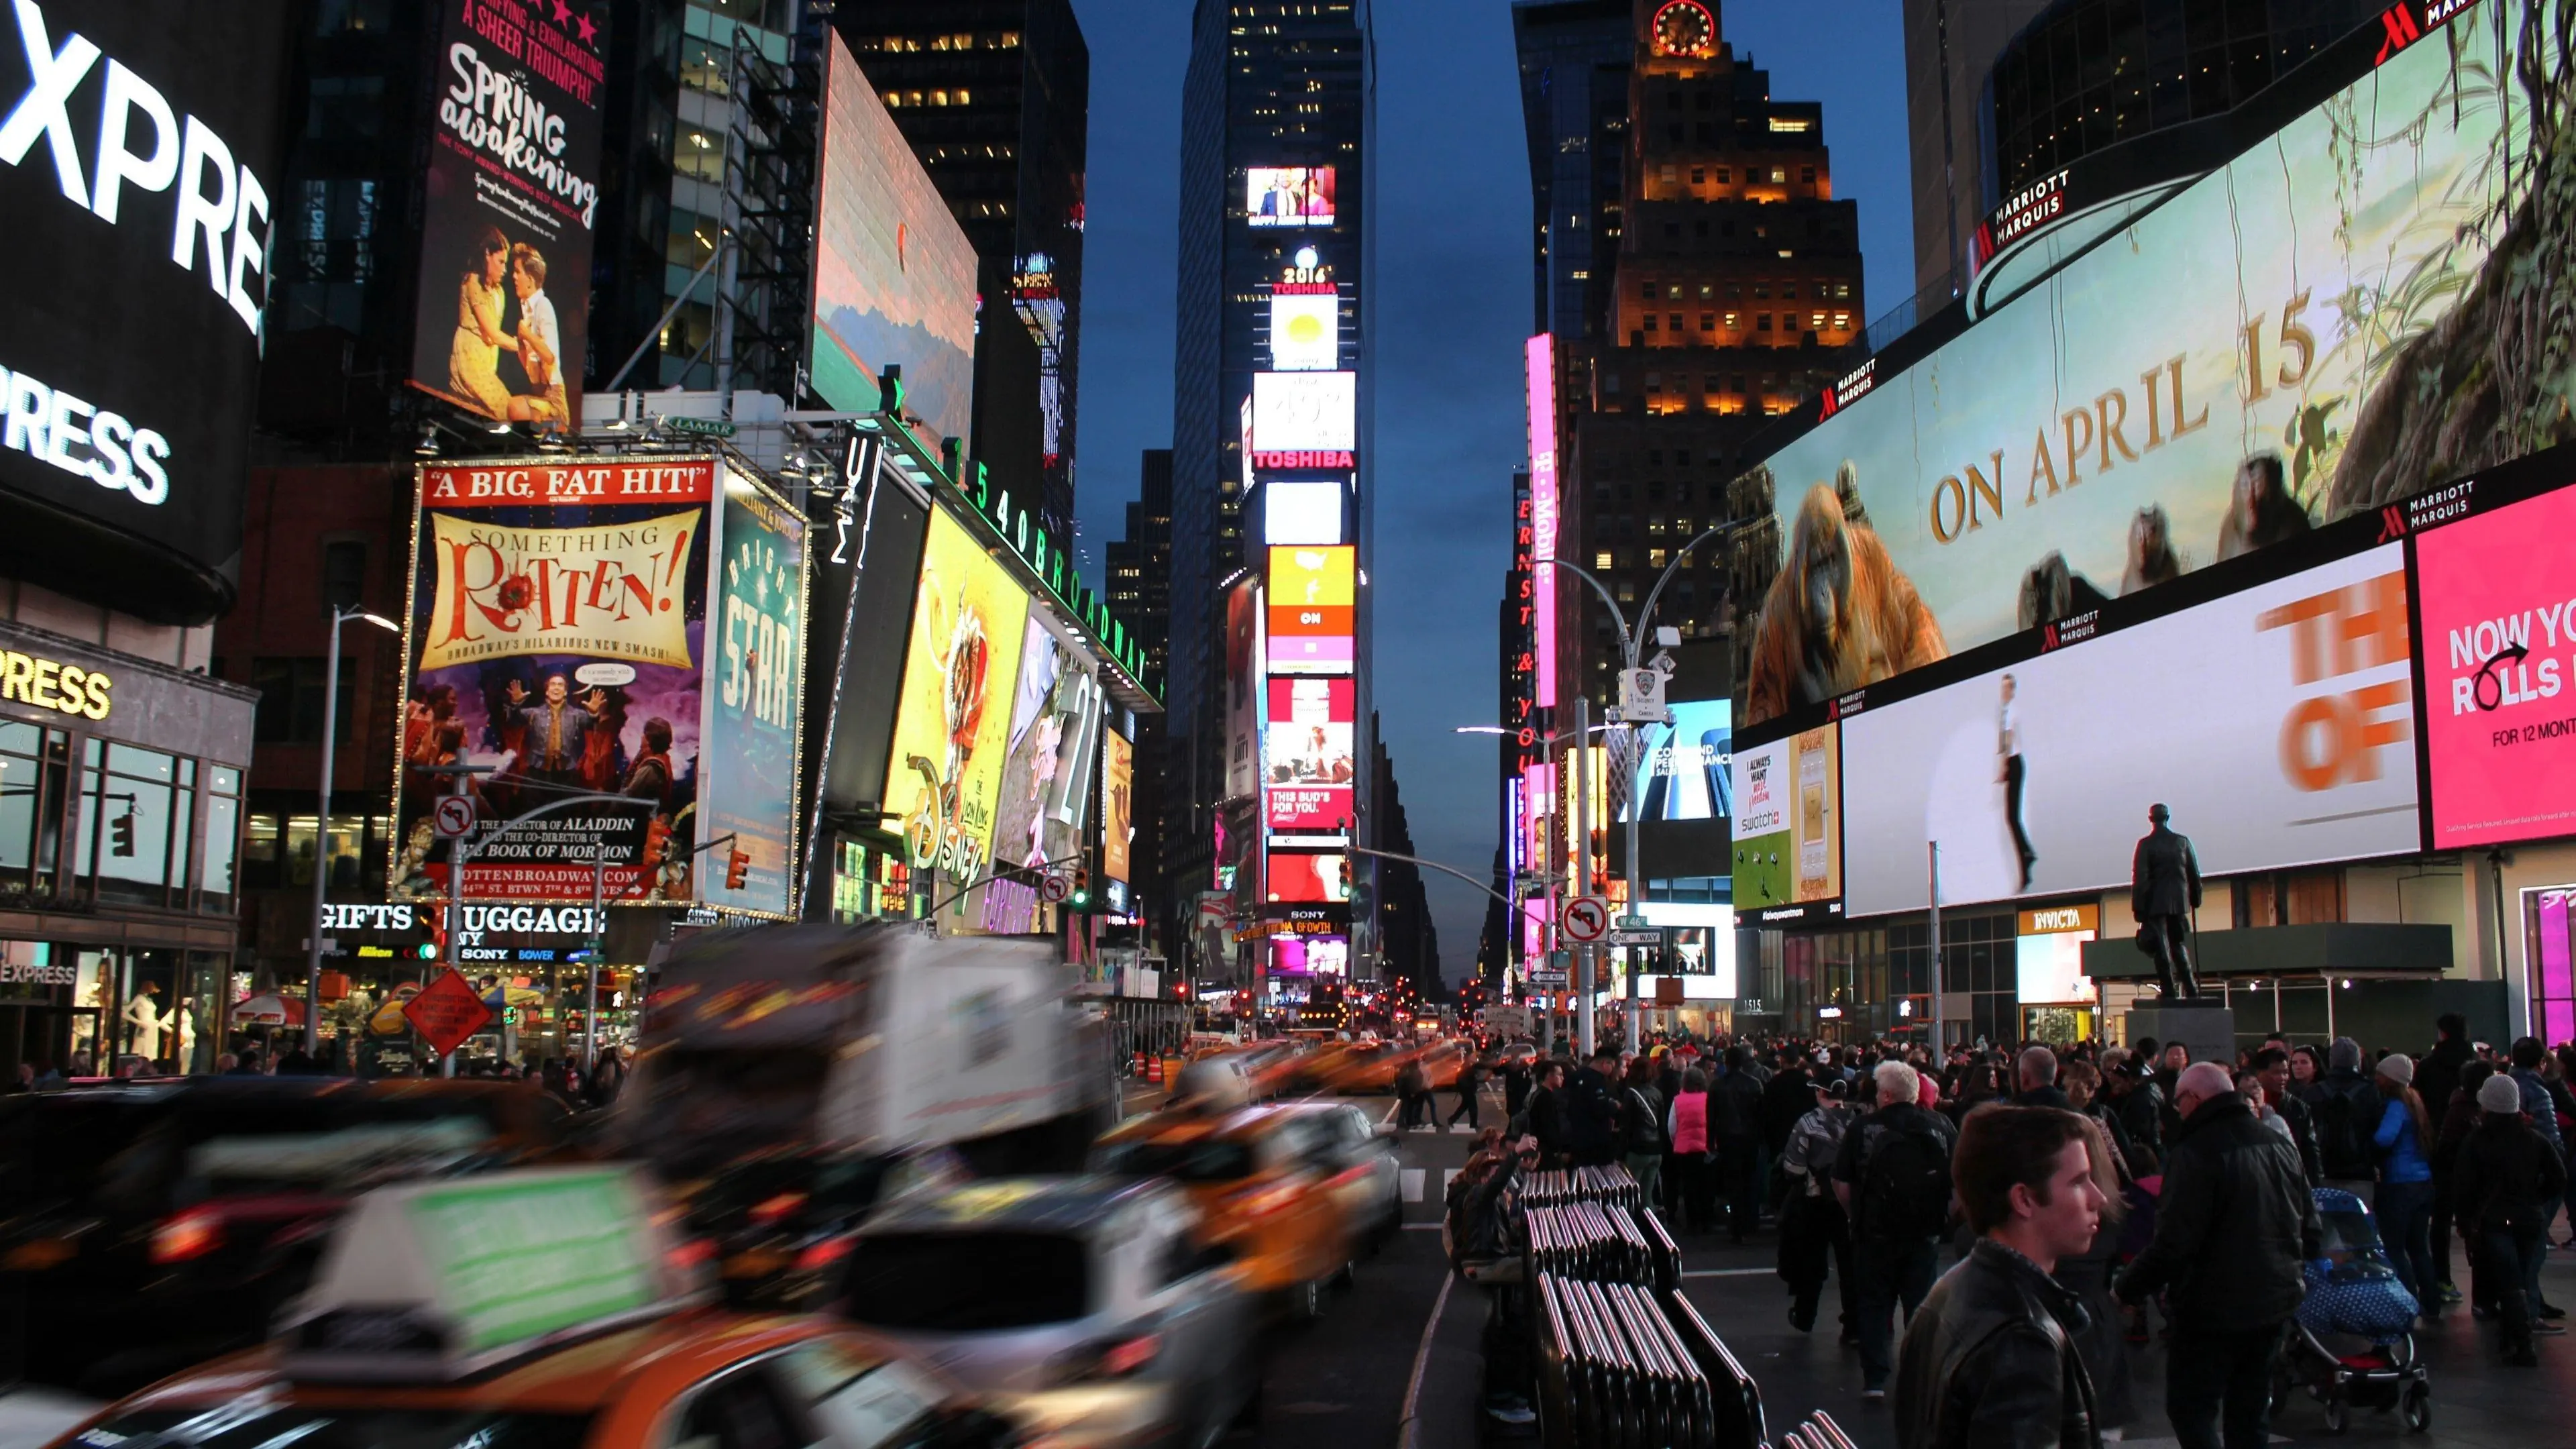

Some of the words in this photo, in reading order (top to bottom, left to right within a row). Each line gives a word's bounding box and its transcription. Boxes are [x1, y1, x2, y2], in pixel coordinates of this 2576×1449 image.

[476, 5, 522, 59] SHEER
[449, 42, 566, 156] SPRING
[440, 97, 599, 229] awakening
[0, 0, 274, 361] XPRE
[1996, 169, 2069, 225] MARRIOTT
[1997, 196, 2059, 246] MARQUIS
[1283, 267, 1326, 284] 2016
[1273, 282, 1336, 294] TOSHIBA
[1838, 358, 1876, 392] MARRIOTT
[1838, 376, 1872, 407] MARQUIS
[676, 417, 731, 435] LAMAR
[1929, 448, 2006, 545] ON
[2025, 350, 2210, 506] APRIL
[2241, 285, 2315, 405] 15
[0, 363, 171, 506] RESS
[1253, 450, 1354, 468] TOSHIBA
[468, 470, 535, 498] BIG,
[545, 469, 611, 495] FAT
[2410, 480, 2474, 513] MARRIOTT
[2410, 499, 2468, 529] MARQUIS
[470, 526, 659, 551] SOMETHING
[1518, 499, 1534, 626] ERNST
[729, 539, 794, 617] BRIGHT
[1035, 527, 1146, 682] BROADWAY
[1300, 612, 1322, 625] ON
[2060, 610, 2099, 630] MARRIOTT
[2061, 624, 2095, 643] MARQUIS
[2449, 610, 2531, 669] NOW
[447, 637, 519, 660] BROADWAY'S
[525, 637, 590, 649] HILARIOUS
[595, 639, 619, 652] NEW
[724, 594, 794, 732] STAR
[0, 649, 112, 720] RESS
[2452, 657, 2561, 716] ROLLS
[1840, 690, 1866, 706] MARRIOTT
[1840, 702, 1863, 716] MARQUIS
[2492, 729, 2519, 747] FOR
[2522, 725, 2535, 742] 12
[1750, 755, 1771, 771] ALWAYS
[1751, 769, 1767, 783] WANT
[1272, 791, 1296, 802] THIS
[1298, 791, 1330, 803] BUD'S
[1272, 802, 1293, 813] FOR
[549, 820, 562, 830] OF
[563, 818, 635, 830] ALADDIN
[1741, 809, 1774, 832] swatch
[504, 833, 522, 842] THE
[525, 833, 588, 843] CO-DIRECTOR
[590, 833, 602, 843] OF
[487, 844, 533, 857] BOOK
[535, 844, 557, 858] OF
[507, 885, 542, 894] BTWN
[564, 885, 572, 895] &
[321, 904, 413, 930] GIFTS
[1291, 911, 1326, 919] SONY
[1620, 917, 1627, 926] W
[1629, 917, 1641, 926] 46
[2033, 908, 2081, 931] INVICTA
[1612, 934, 1629, 942] ONE
[1639, 933, 1658, 941] WAY
[357, 945, 393, 958] Nikon
[461, 949, 508, 960] SONY
[518, 949, 556, 961] BOWER
[1, 964, 76, 985] EXPRESS
[1744, 999, 1762, 1012] 1515
